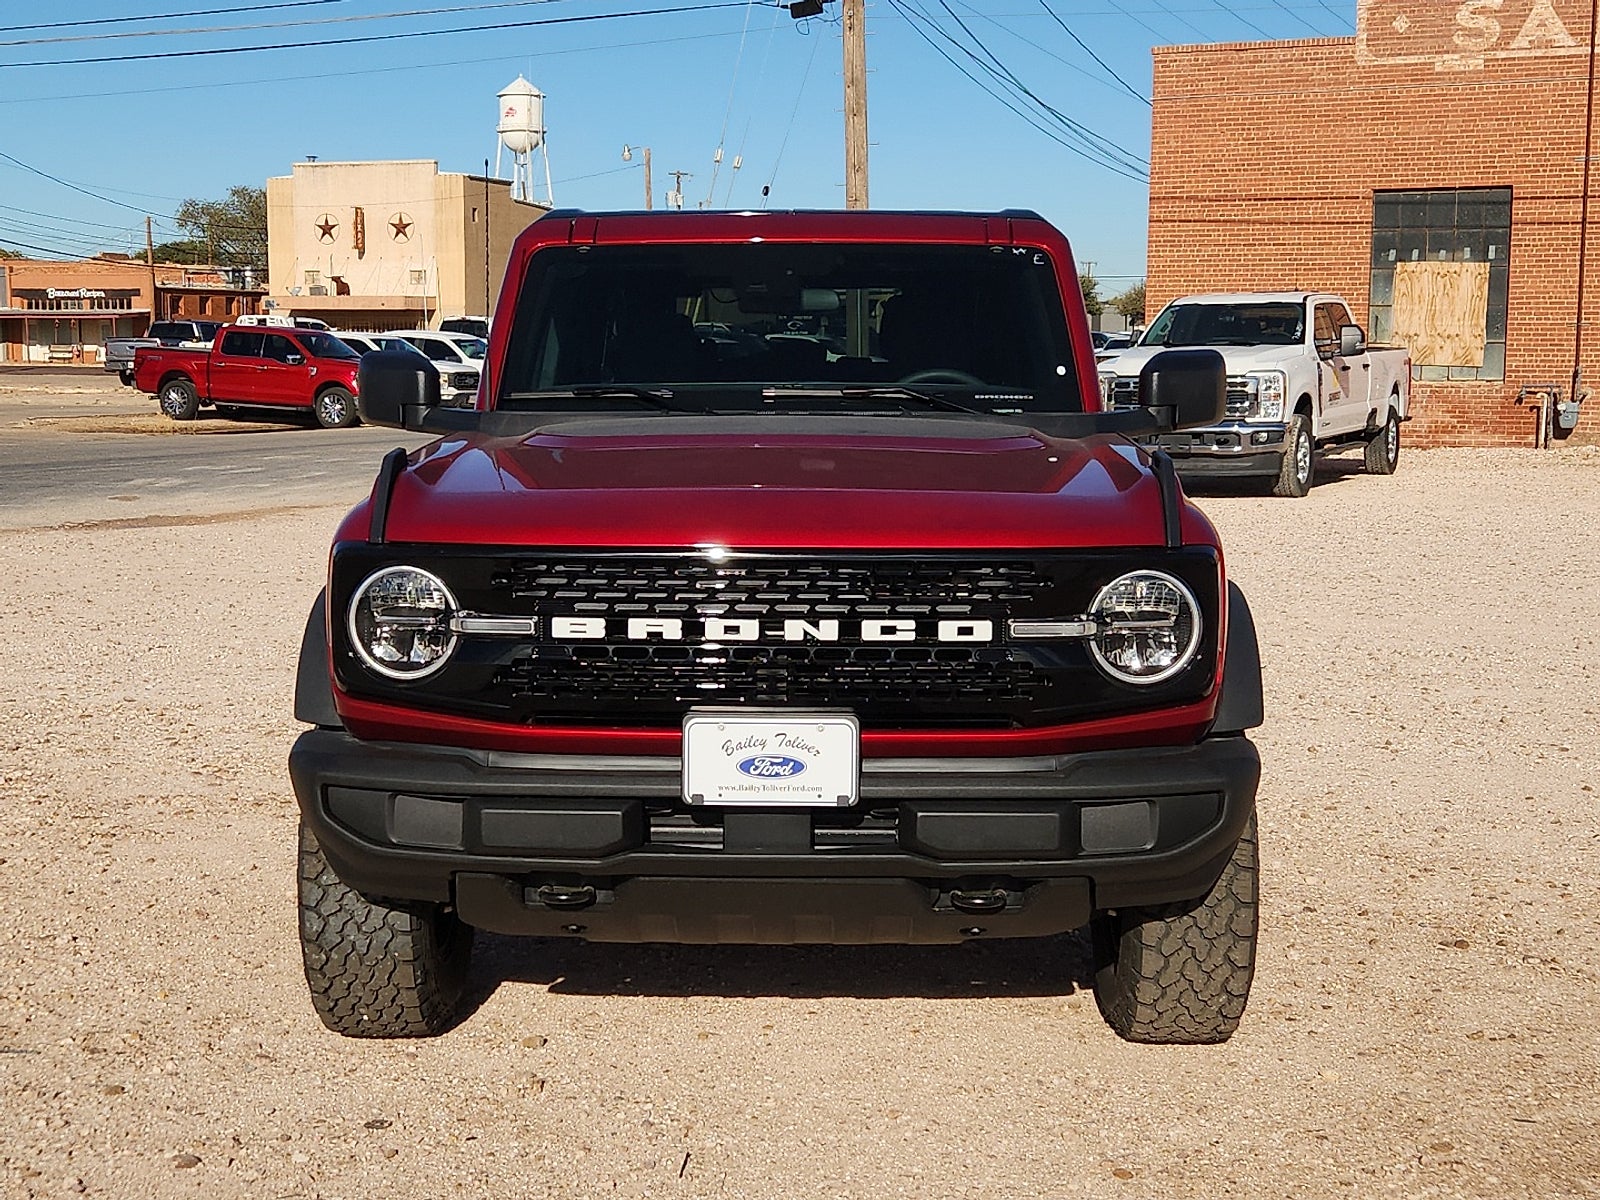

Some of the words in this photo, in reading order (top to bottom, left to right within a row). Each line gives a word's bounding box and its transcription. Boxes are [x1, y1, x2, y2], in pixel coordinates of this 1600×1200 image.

[551, 616, 993, 642] BRONCO
[721, 735, 767, 757] Bailey
[774, 732, 821, 757] Toliver
[749, 755, 795, 776] Ford
